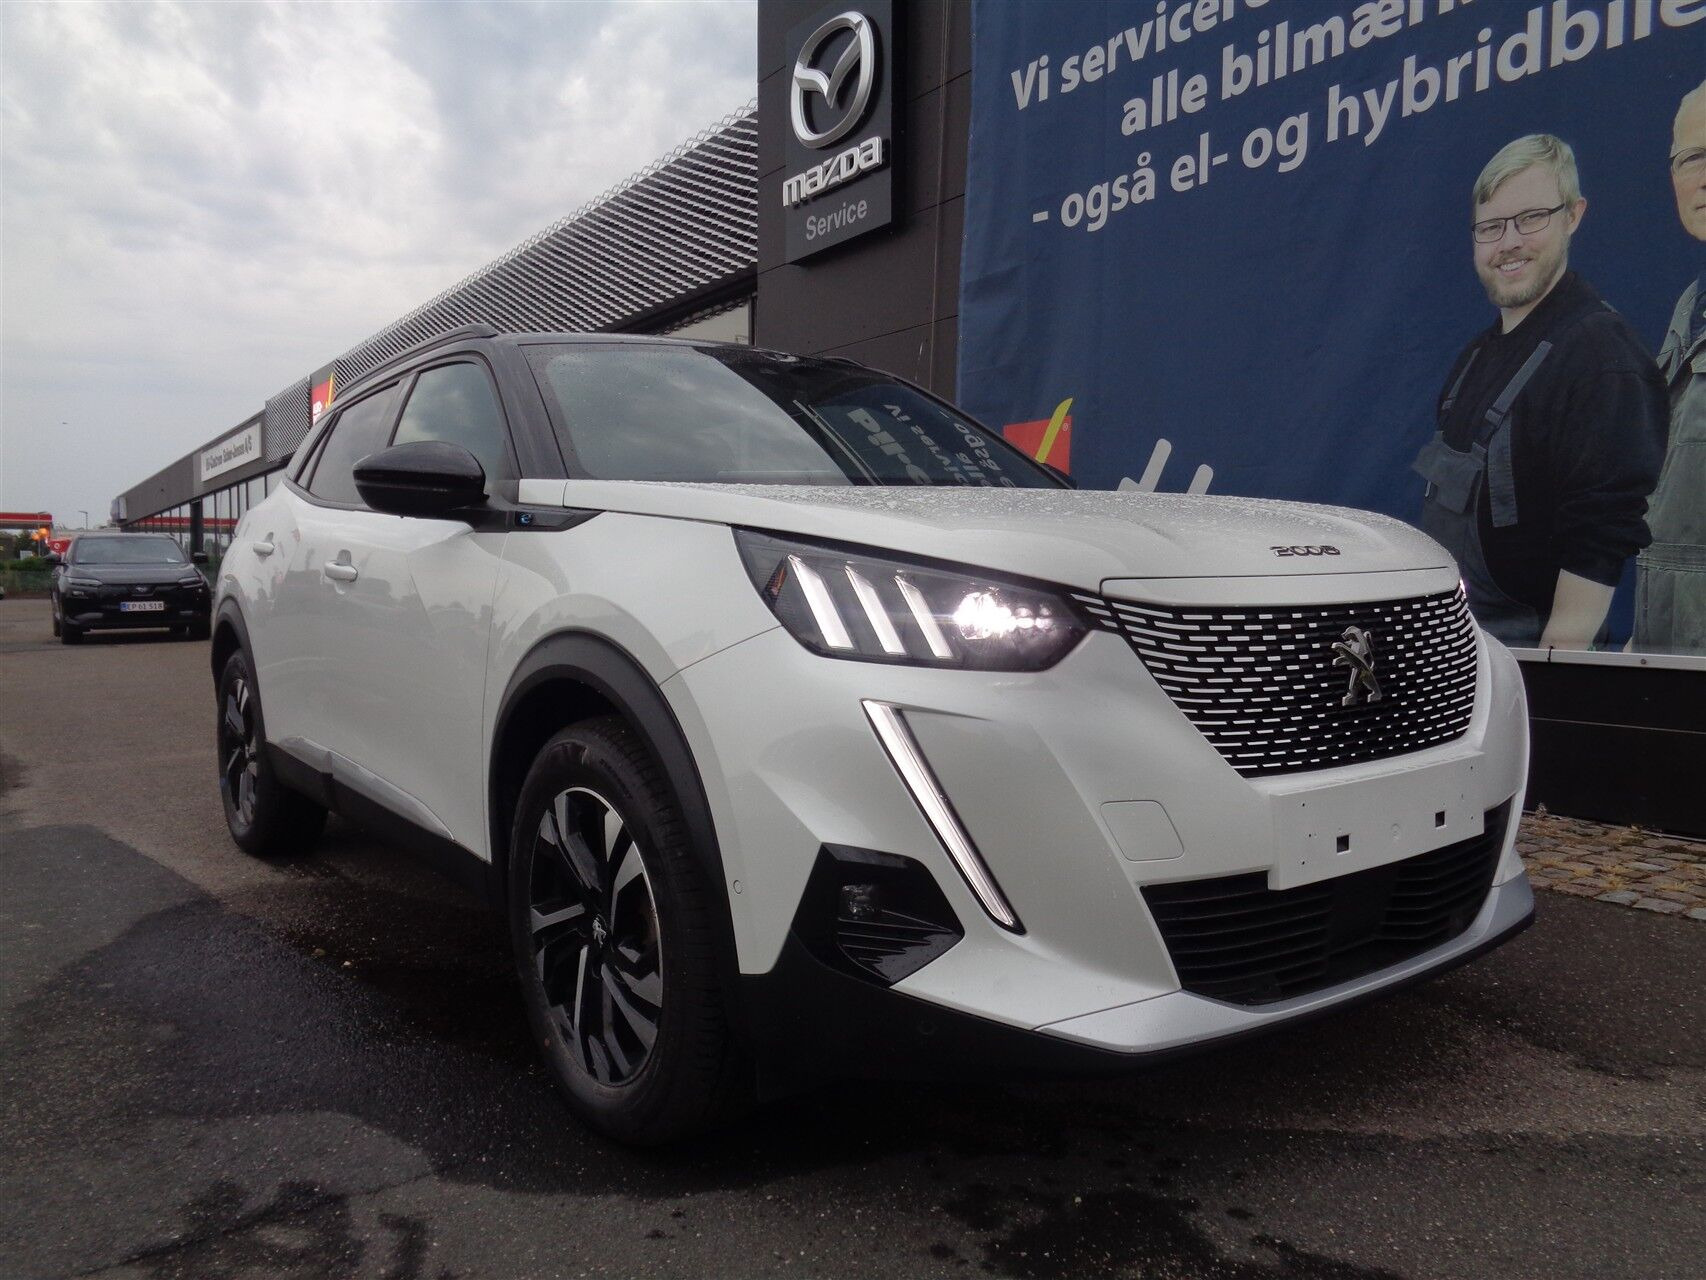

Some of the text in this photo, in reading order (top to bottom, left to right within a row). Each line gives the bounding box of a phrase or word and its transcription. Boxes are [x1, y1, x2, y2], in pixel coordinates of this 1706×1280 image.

[1010, 54, 1049, 110] Vi
[1121, 68, 1208, 136] alle
[1060, 151, 1156, 232] også
[1170, 131, 1228, 192] el-
[1241, 111, 1309, 173] og
[806, 199, 868, 241] Service
[1269, 546, 1341, 558] 2008
